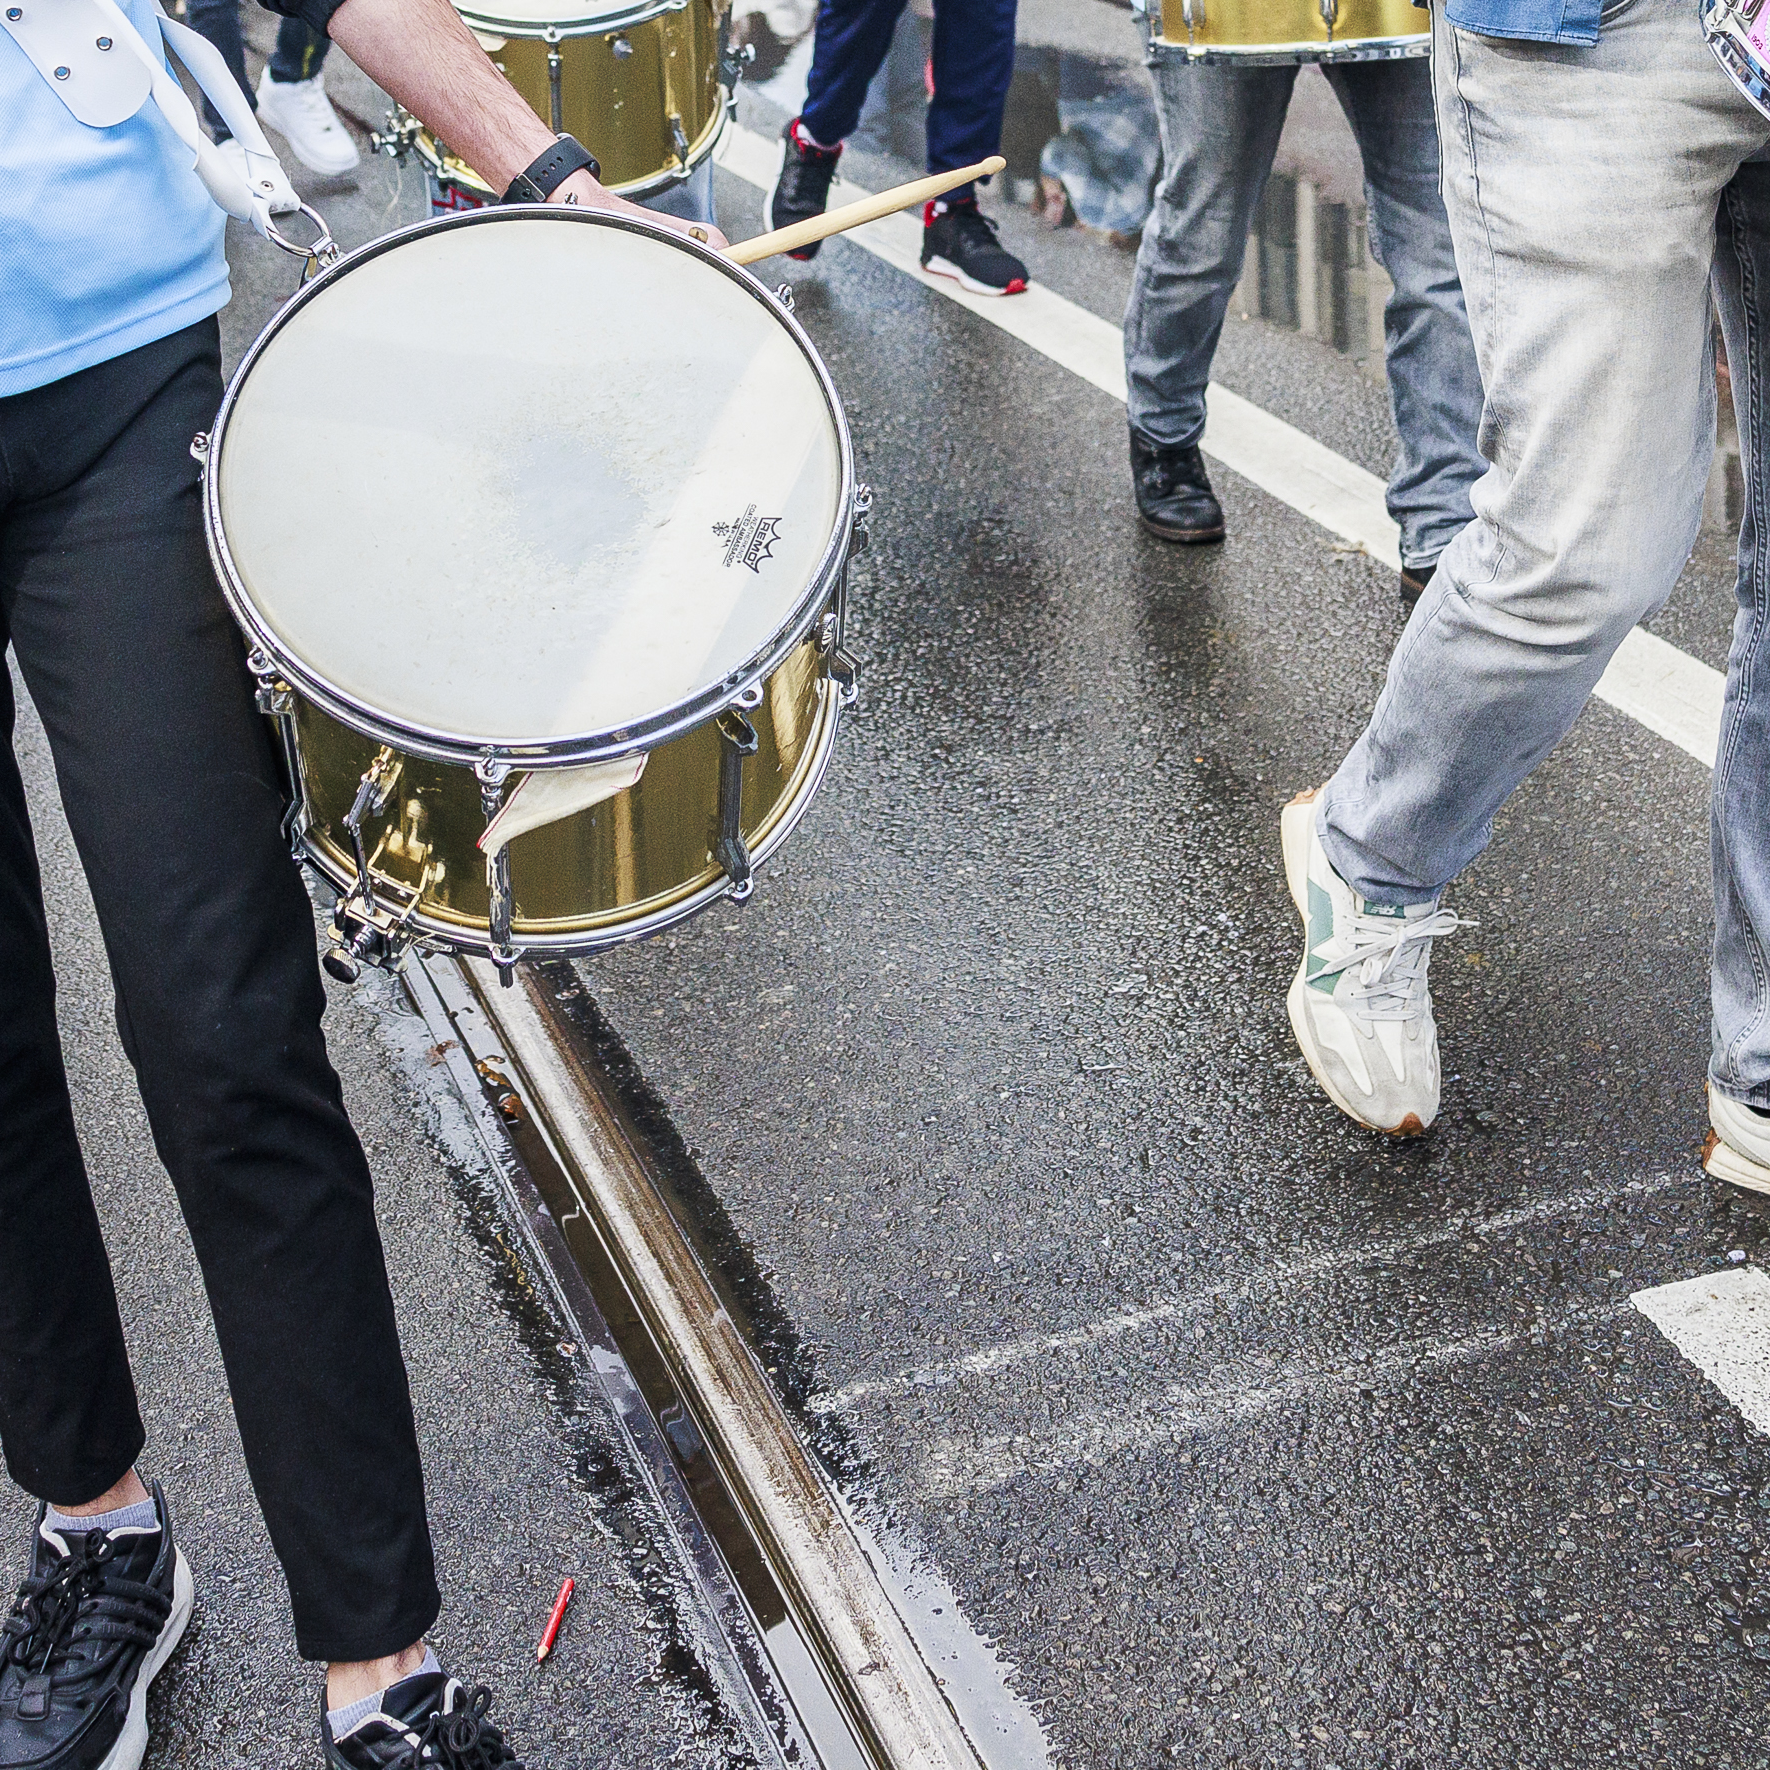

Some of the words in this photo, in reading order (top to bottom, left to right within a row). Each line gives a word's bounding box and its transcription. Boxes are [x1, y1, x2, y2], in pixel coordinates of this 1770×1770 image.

[742, 503, 757, 527] COATED
[726, 526, 747, 568] AMBASSADOR
[747, 521, 771, 563] REMO
